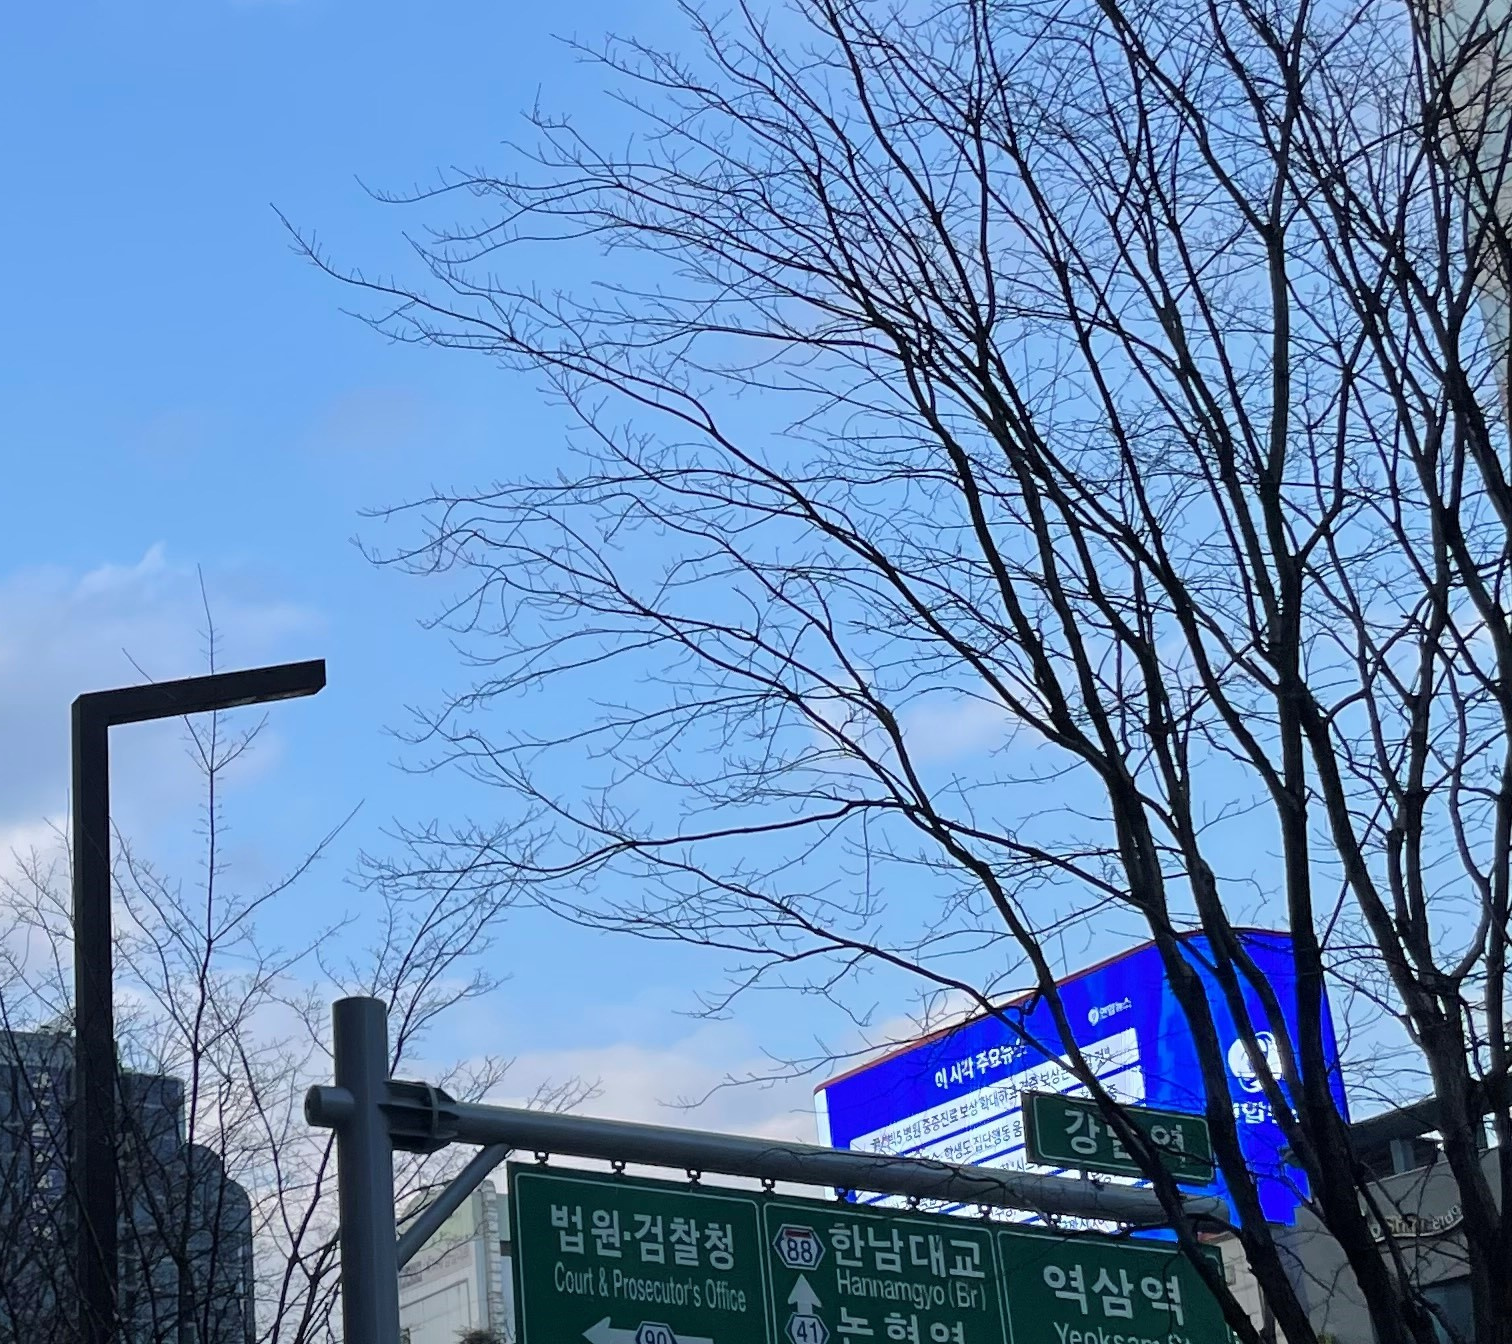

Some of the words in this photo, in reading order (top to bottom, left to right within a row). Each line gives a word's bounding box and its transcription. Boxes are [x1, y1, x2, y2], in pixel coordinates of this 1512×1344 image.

[787, 1239, 813, 1264] 88
[828, 1223, 985, 1279] 한남대교
[554, 1261, 594, 1296] Court
[598, 1267, 608, 1297] &
[613, 1269, 701, 1308] Prosecutor's
[704, 1278, 747, 1313] Office
[836, 1268, 944, 1311] Hannamgyo
[948, 1278, 986, 1312] (Br)
[1043, 1264, 1184, 1327] 역삼역
[796, 1320, 819, 1344] 41
